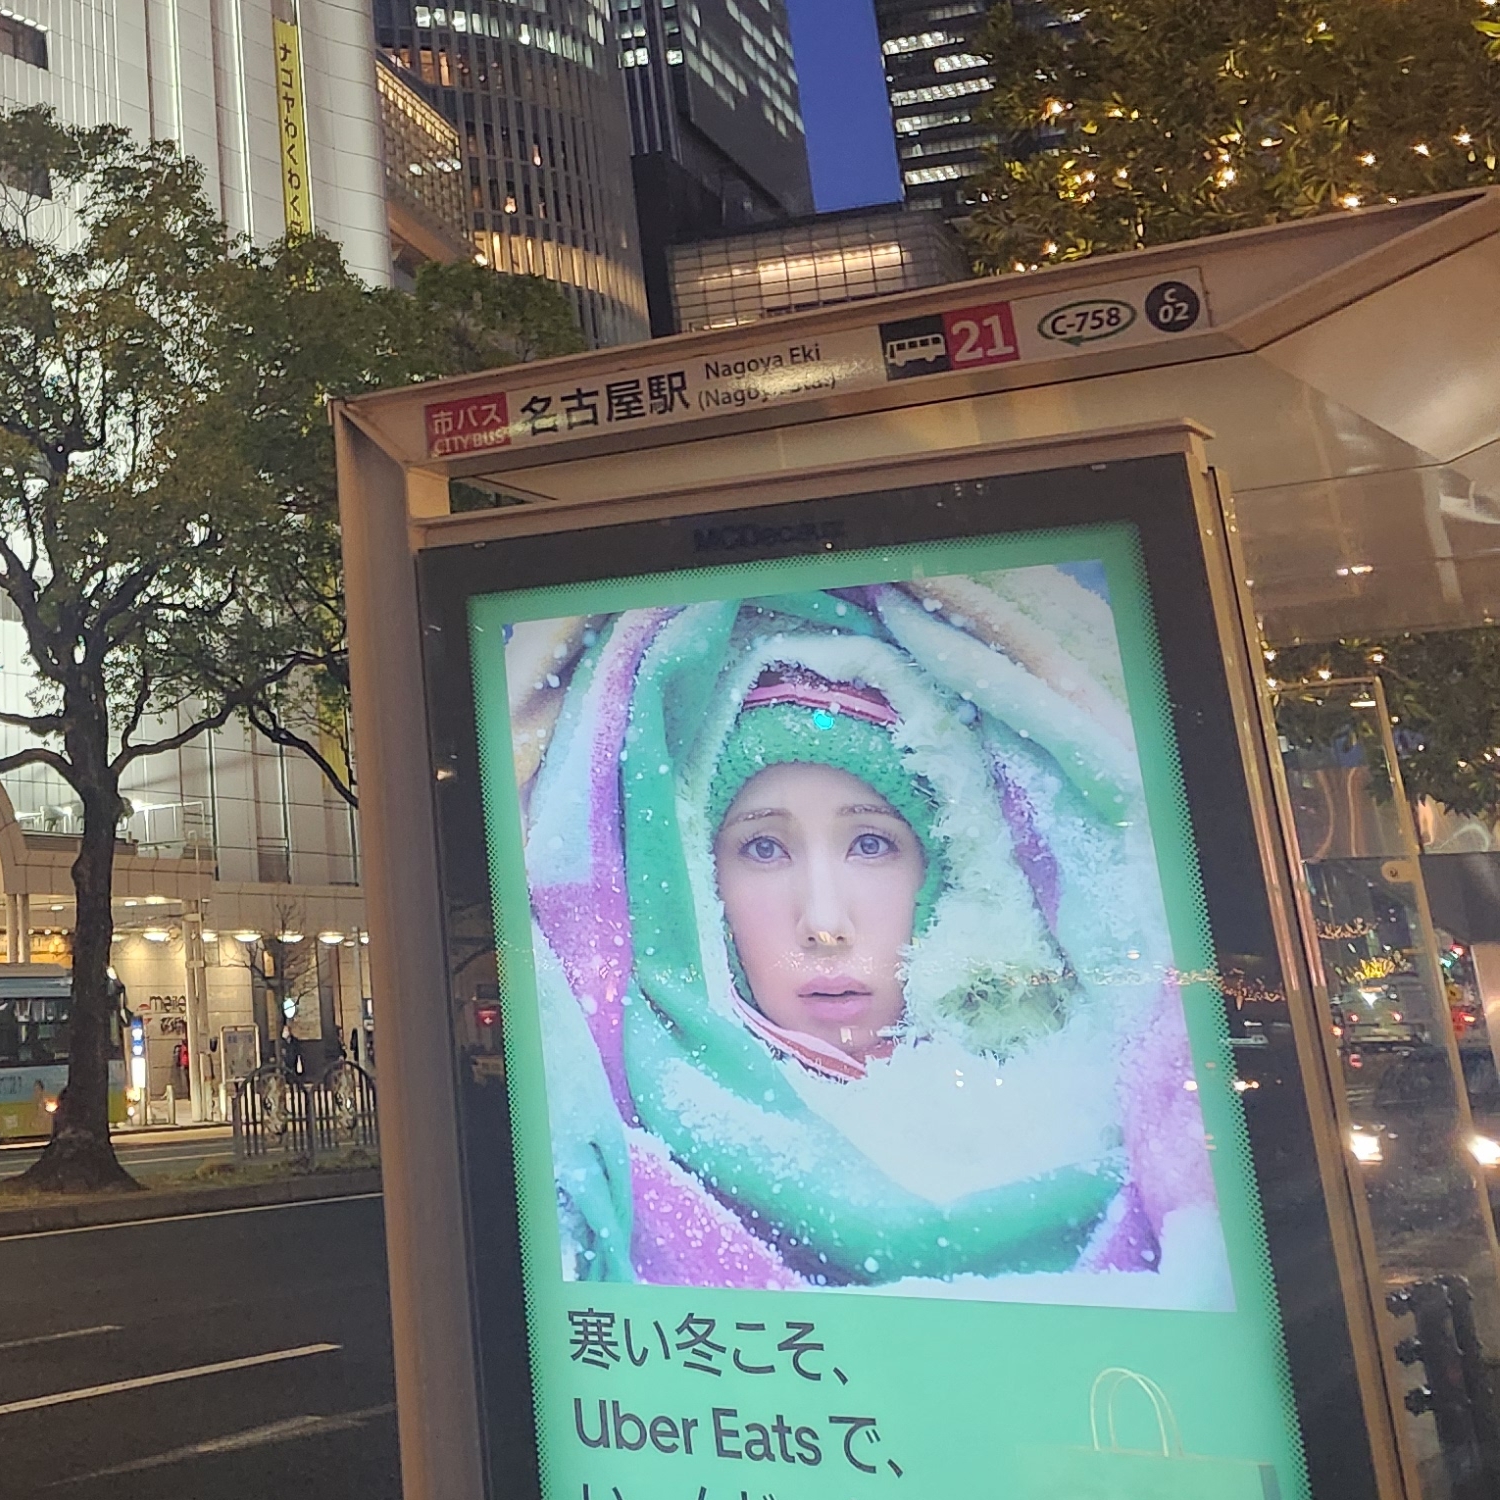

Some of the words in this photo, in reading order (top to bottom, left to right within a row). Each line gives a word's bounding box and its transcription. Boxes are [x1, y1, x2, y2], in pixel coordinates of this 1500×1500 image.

[1163, 287, 1177, 303] C
[1051, 306, 1122, 336] C-758
[1158, 302, 1190, 325] 02
[952, 314, 1015, 362] 21
[704, 353, 784, 380] Nagoya
[789, 342, 822, 366] Eki
[520, 371, 691, 437] 名古屋駅
[698, 382, 786, 412] (Nago
[431, 402, 503, 436] 市バス
[433, 435, 470, 454] CITY
[473, 427, 506, 448] BUS
[567, 1306, 849, 1386] 寒い冬こそ、
[573, 1397, 699, 1455] Uber
